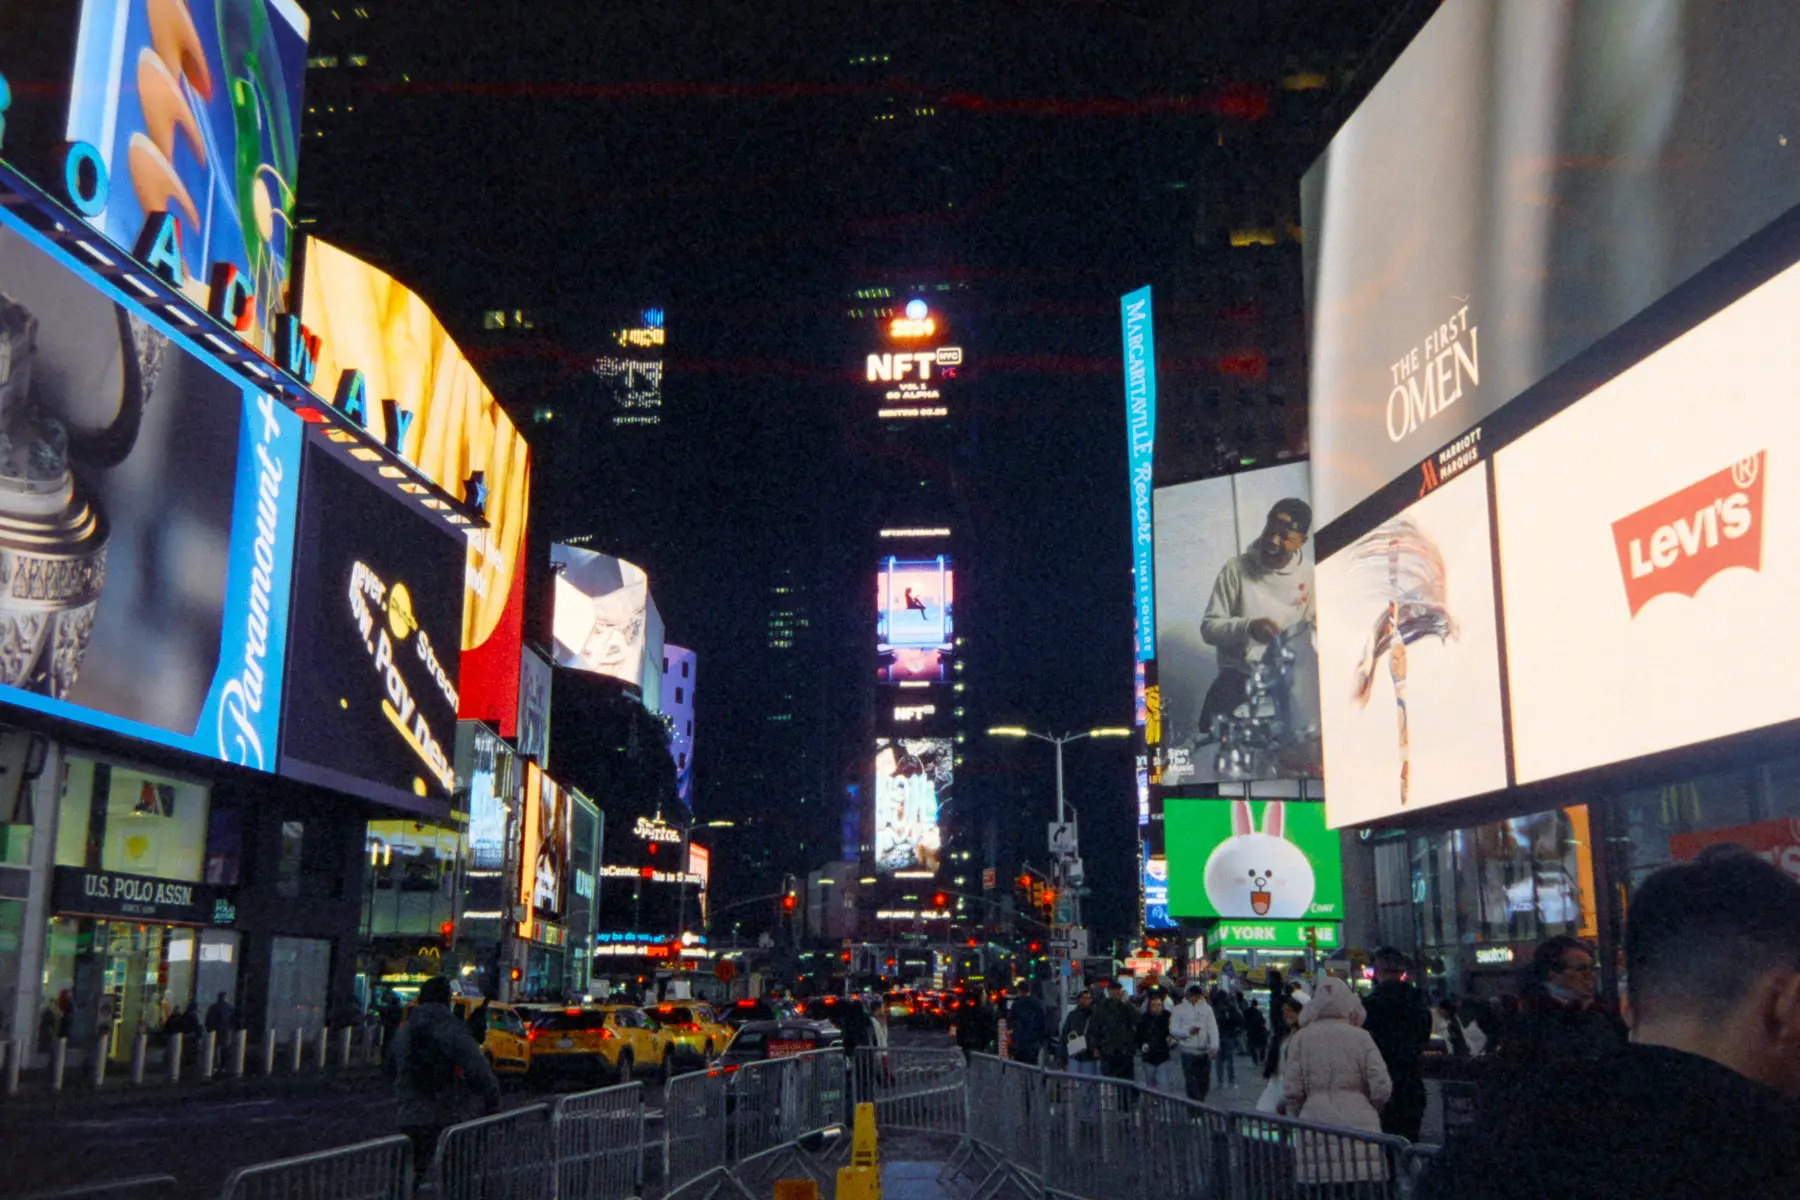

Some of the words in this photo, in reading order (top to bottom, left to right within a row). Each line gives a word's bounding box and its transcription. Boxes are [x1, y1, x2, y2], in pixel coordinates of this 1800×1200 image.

[1390, 347, 1420, 385] THE
[1425, 305, 1469, 361] FIRST
[866, 351, 937, 382] NFT
[1386, 326, 1480, 443] OMEN
[1438, 427, 1483, 466] MARRIOTT
[1439, 446, 1479, 481] MARQUIS
[1132, 461, 1152, 546] Resort
[374, 627, 415, 725] Pay
[1167, 747, 1190, 757] Save
[1169, 756, 1186, 765] The
[84, 874, 111, 898] U.S.
[113, 878, 153, 902] POLO
[1231, 926, 1277, 941] YORK
[1297, 927, 1334, 942] LNE
